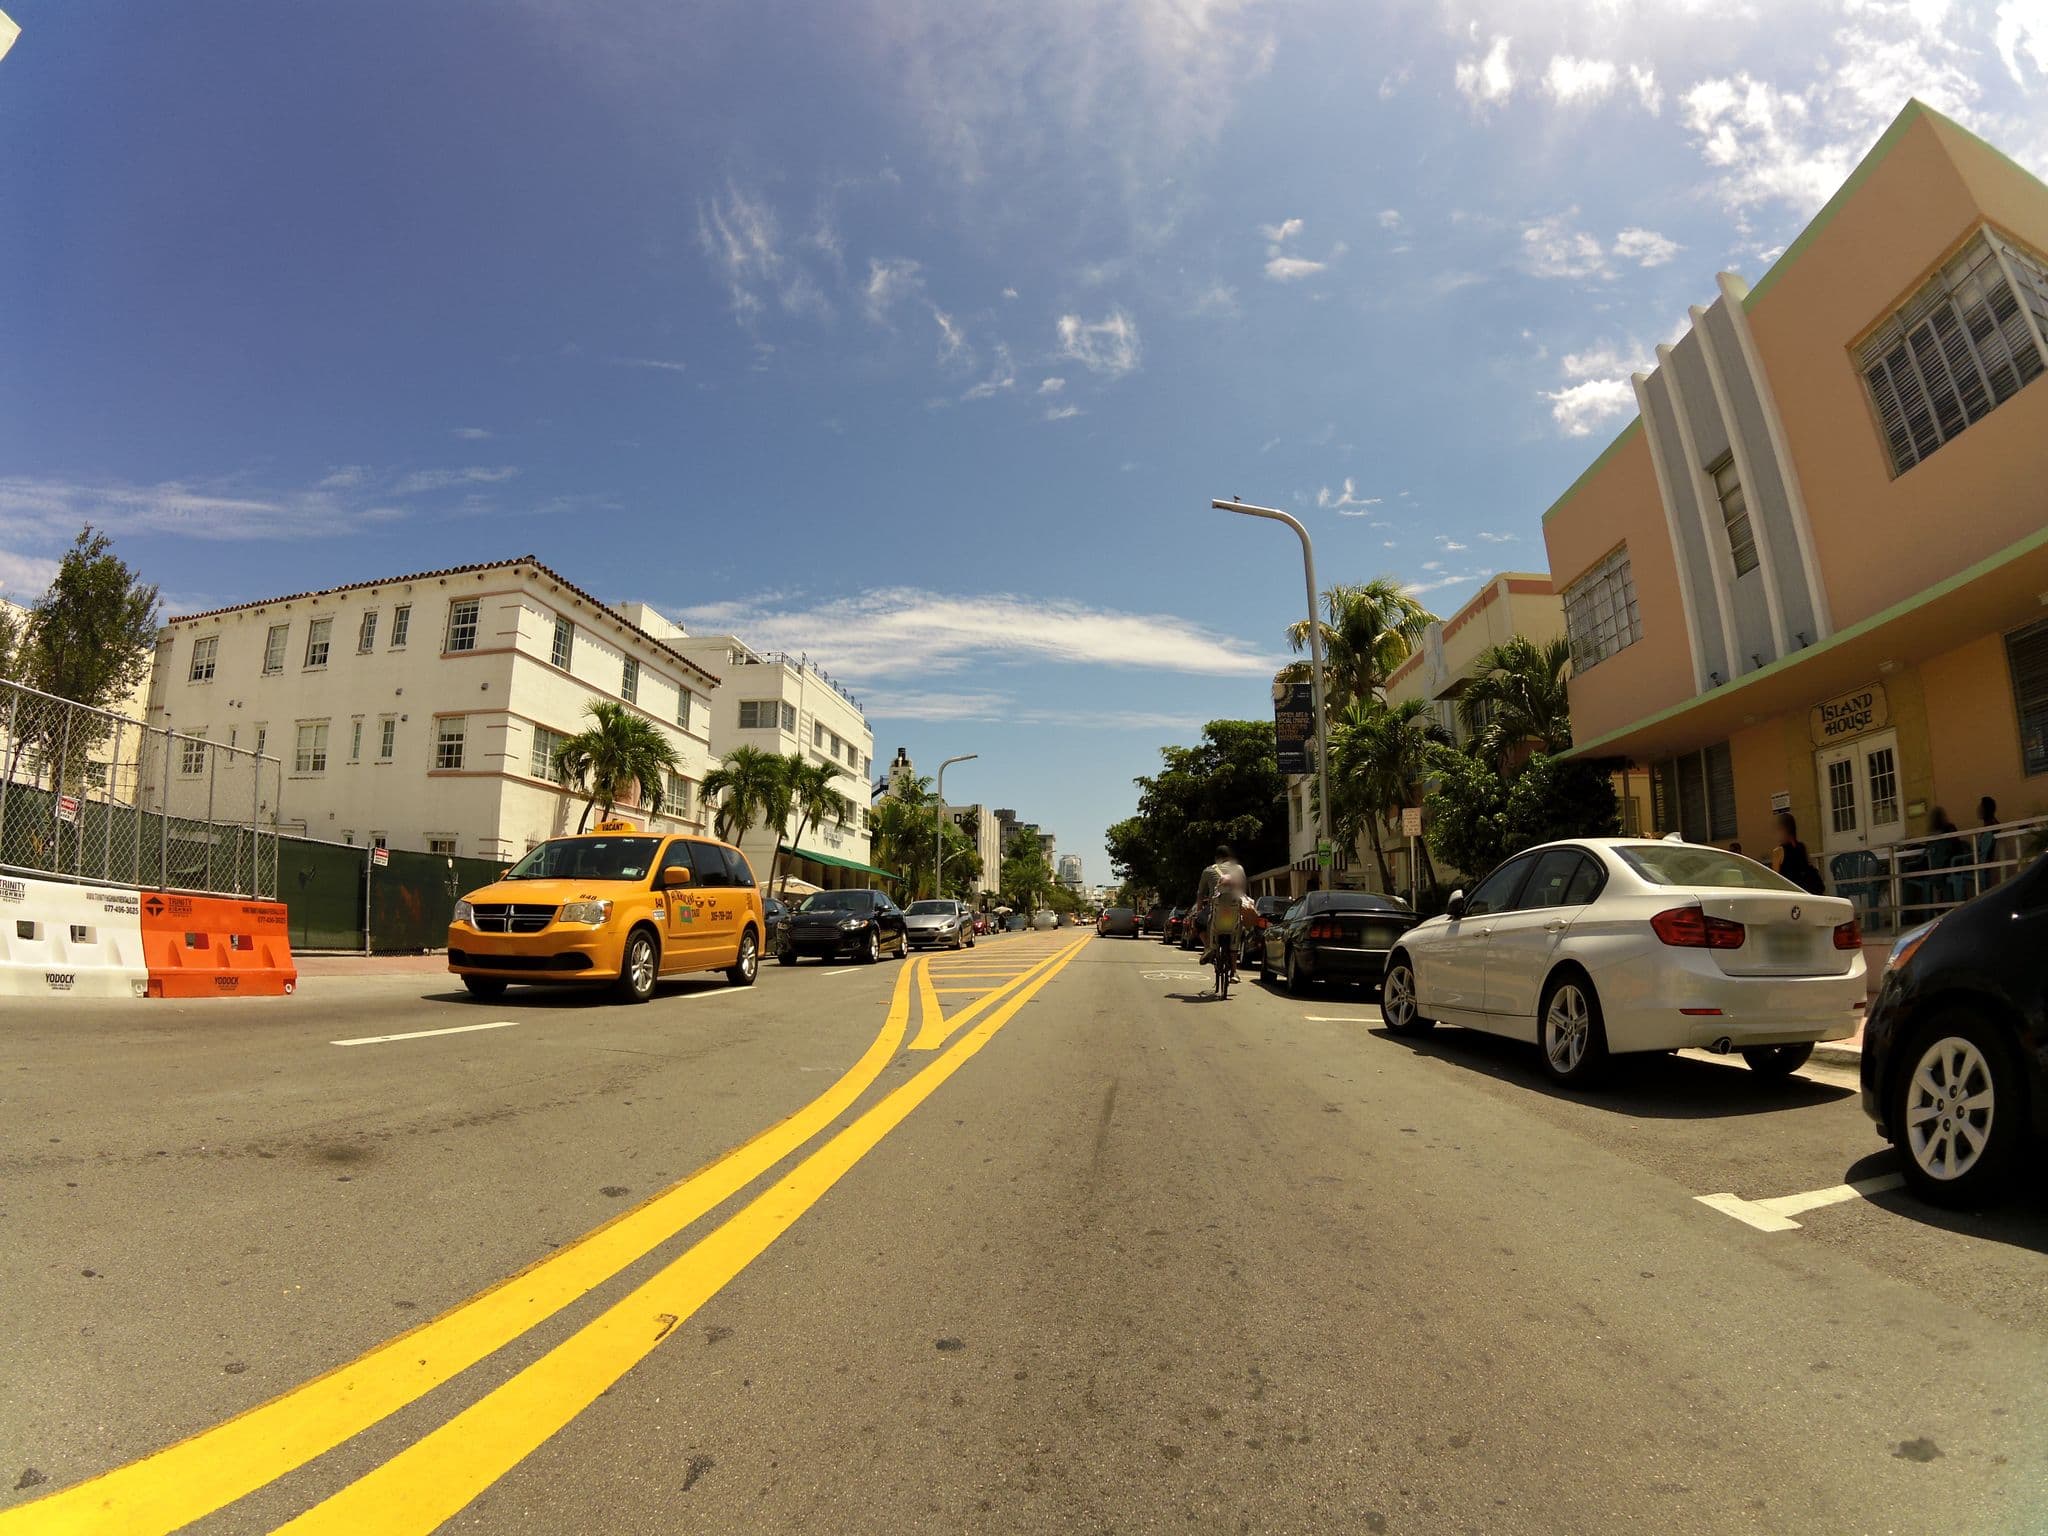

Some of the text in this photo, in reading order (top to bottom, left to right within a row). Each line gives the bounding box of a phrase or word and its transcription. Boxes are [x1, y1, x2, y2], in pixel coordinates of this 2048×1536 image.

[1821, 693, 1873, 722] ISLAND
[1825, 710, 1873, 736] HOUSE
[602, 823, 624, 831] VACANT
[45, 973, 75, 984] YODOCK
[214, 976, 239, 985] YODOCK
